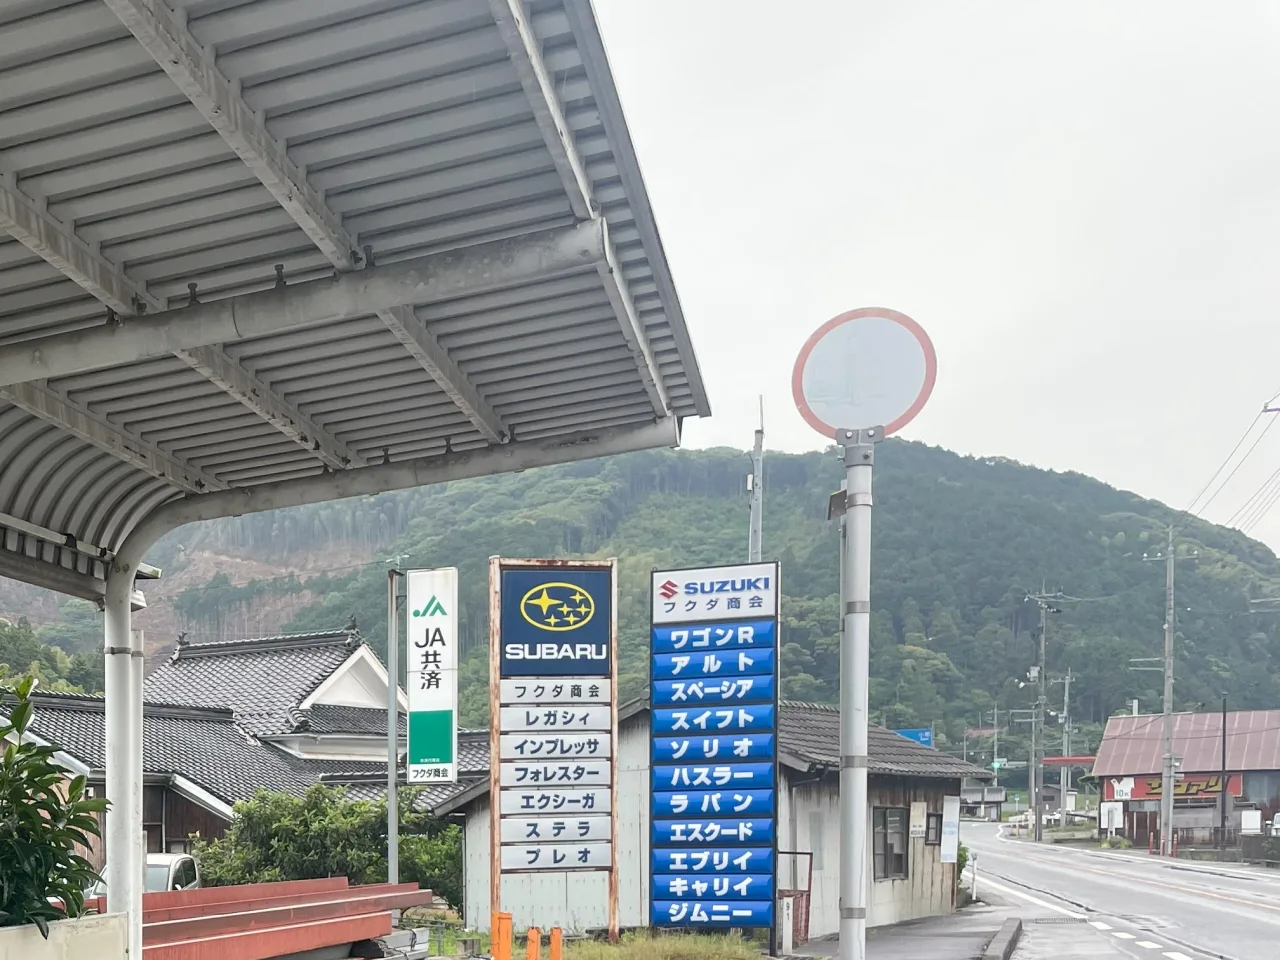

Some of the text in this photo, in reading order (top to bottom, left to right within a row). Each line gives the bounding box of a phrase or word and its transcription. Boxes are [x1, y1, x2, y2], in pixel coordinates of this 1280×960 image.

[684, 577, 770, 595] SUZUKI
[663, 595, 764, 614] フクダ商会
[670, 626, 755, 649] ワゴンR
[505, 643, 607, 660] SUBARU
[671, 652, 754, 675] アルト
[514, 684, 600, 699] フクダ商会
[671, 679, 754, 701] スペーシア
[671, 709, 754, 731] スイフト
[514, 738, 600, 755] インプレッサ
[670, 737, 753, 759] ソリオ
[514, 765, 600, 782] フォレスター
[670, 766, 754, 786] ハスラー
[520, 793, 596, 810] エクシーガ
[670, 792, 753, 813] ラパン
[525, 821, 590, 839] ステラ
[670, 822, 753, 842] エスクード
[526, 847, 591, 865] プレオ
[669, 850, 753, 871] エブリイ
[669, 876, 753, 897] キャリイ
[668, 902, 753, 922] ジムニー
